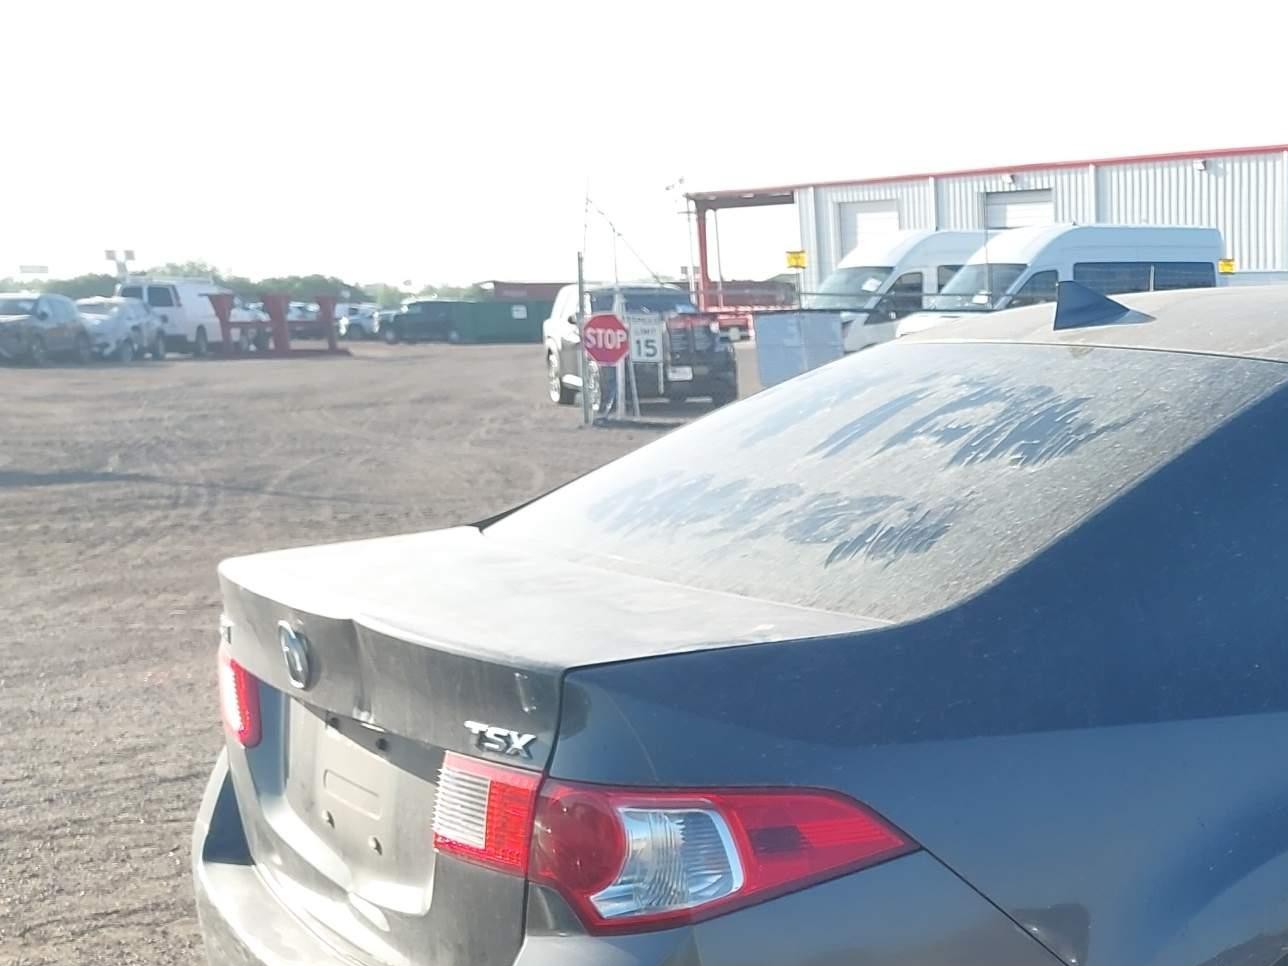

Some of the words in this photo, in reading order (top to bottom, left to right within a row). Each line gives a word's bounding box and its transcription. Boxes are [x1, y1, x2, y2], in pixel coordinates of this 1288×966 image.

[585, 327, 628, 349] STOP
[636, 339, 658, 358] 15
[463, 720, 538, 760] TSX
